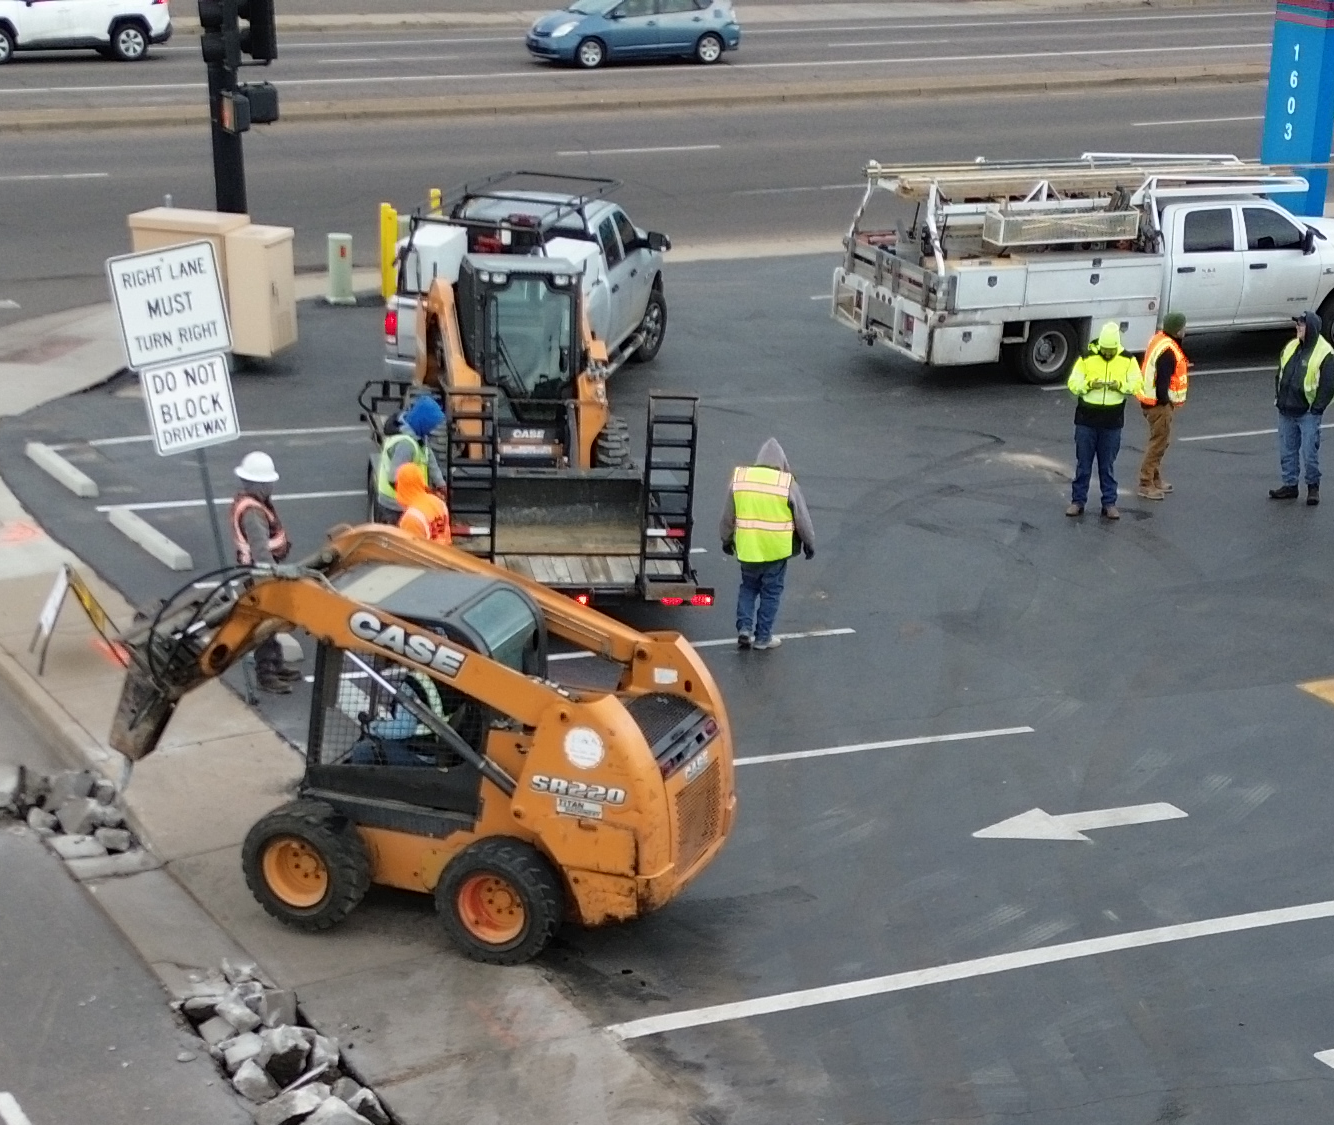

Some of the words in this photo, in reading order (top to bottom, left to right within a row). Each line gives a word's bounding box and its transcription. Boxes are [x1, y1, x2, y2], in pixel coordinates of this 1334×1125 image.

[1283, 43, 1300, 141] 1603
[121, 265, 163, 290] RIGHT
[169, 257, 207, 280] LANE
[146, 291, 193, 319] MUST
[135, 331, 173, 353] TURN
[178, 320, 218, 344] RIGHT
[152, 371, 177, 395] DO
[183, 362, 217, 387] NOT
[160, 393, 223, 424] BLOCK
[162, 416, 228, 446] DRIVEWAY
[513, 429, 545, 439] CASE
[349, 610, 467, 678] CASE
[531, 774, 626, 805] SR220
[558, 798, 585, 810] TITAN
